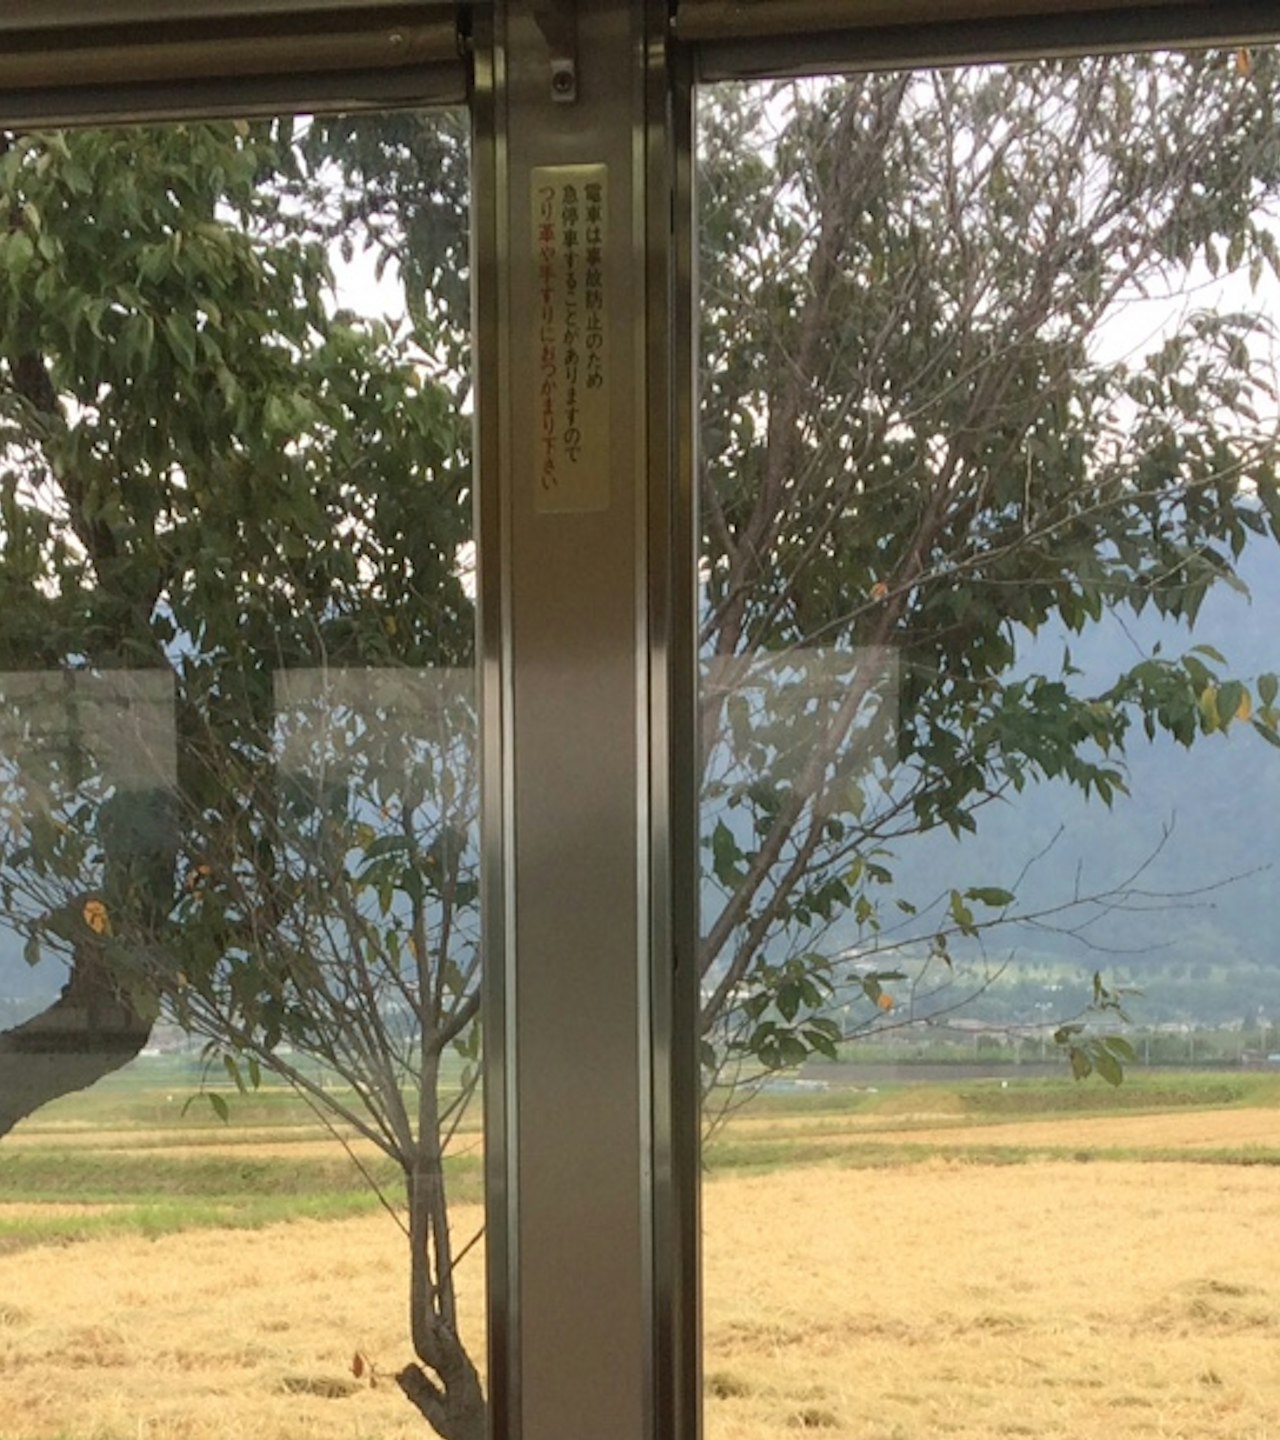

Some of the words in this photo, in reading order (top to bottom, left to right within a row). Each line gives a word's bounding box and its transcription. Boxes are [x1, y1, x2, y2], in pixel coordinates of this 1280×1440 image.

[537, 185, 558, 491] つり革や手すりにおつかまり下さい
[561, 184, 582, 463] 急停車することがありますので
[584, 182, 604, 389] 電車は事故防止のため
